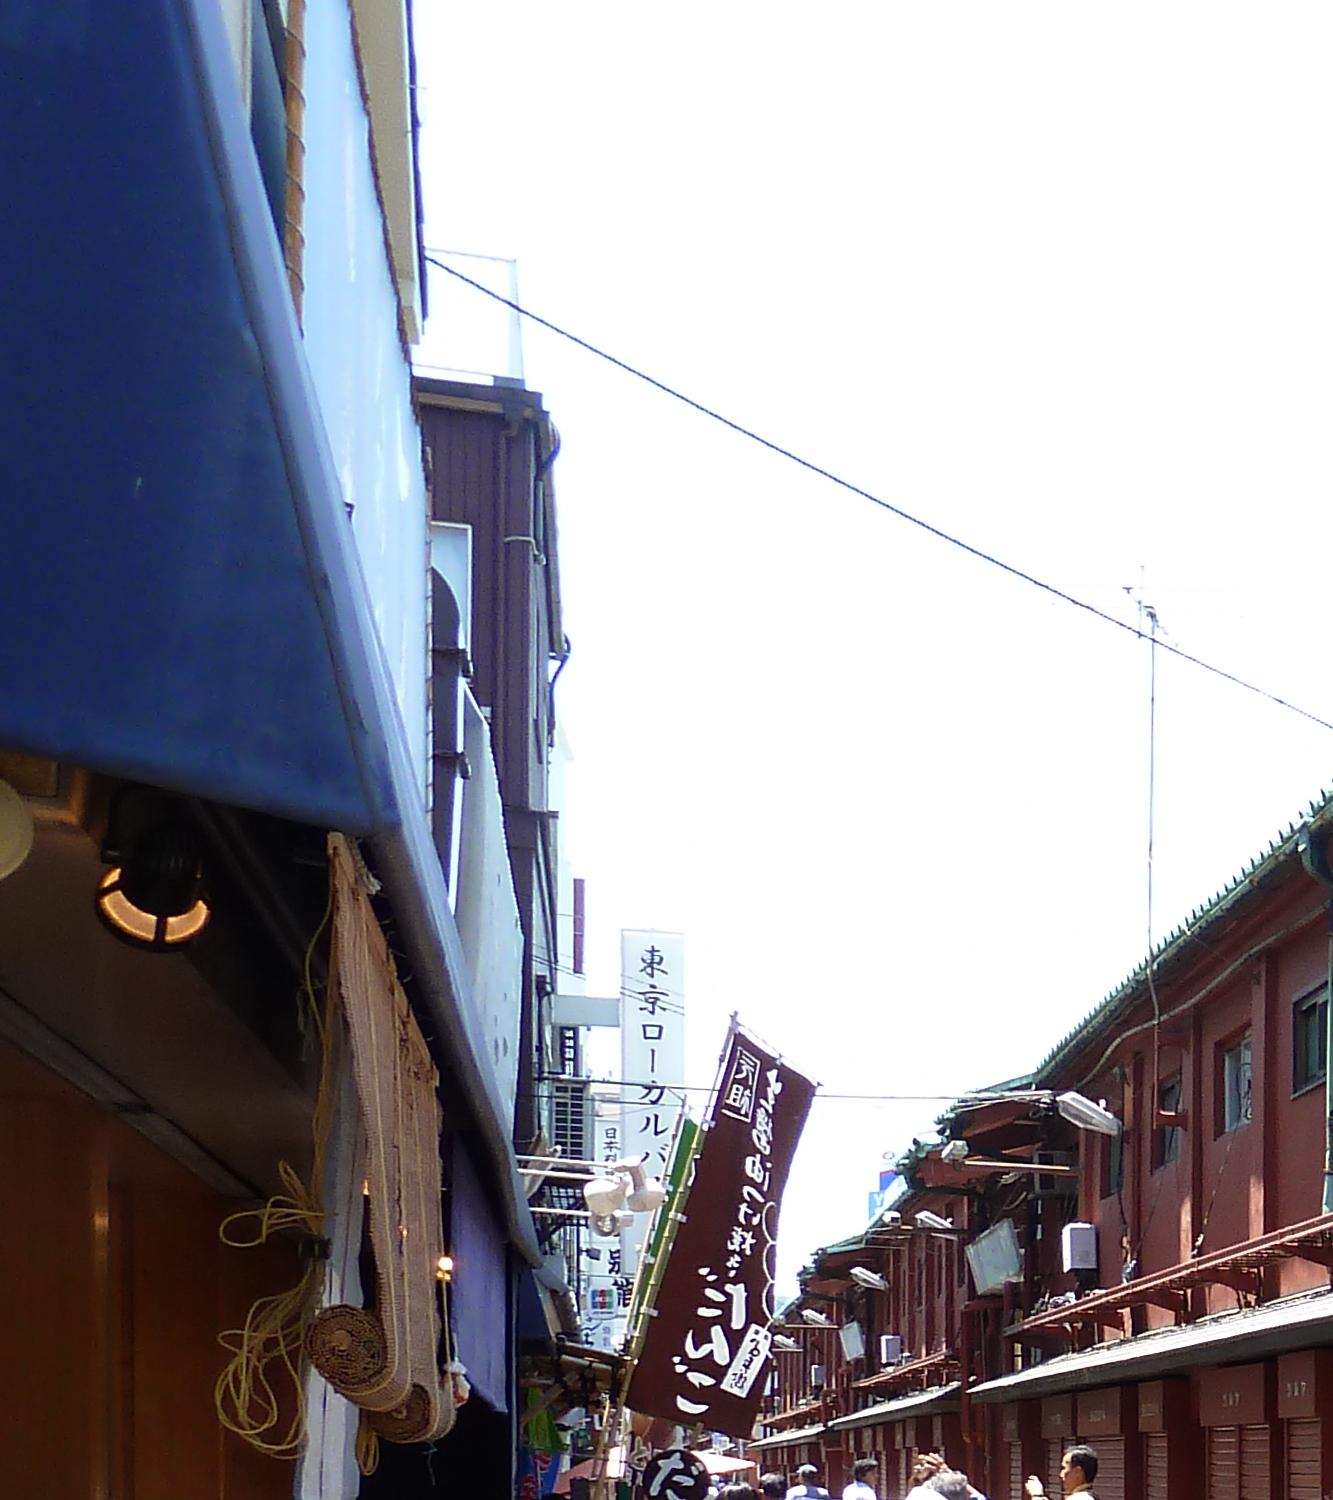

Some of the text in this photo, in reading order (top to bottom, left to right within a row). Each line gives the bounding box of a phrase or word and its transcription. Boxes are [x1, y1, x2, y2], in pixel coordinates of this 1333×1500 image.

[639, 944, 670, 1183] 東京ローカルバ
